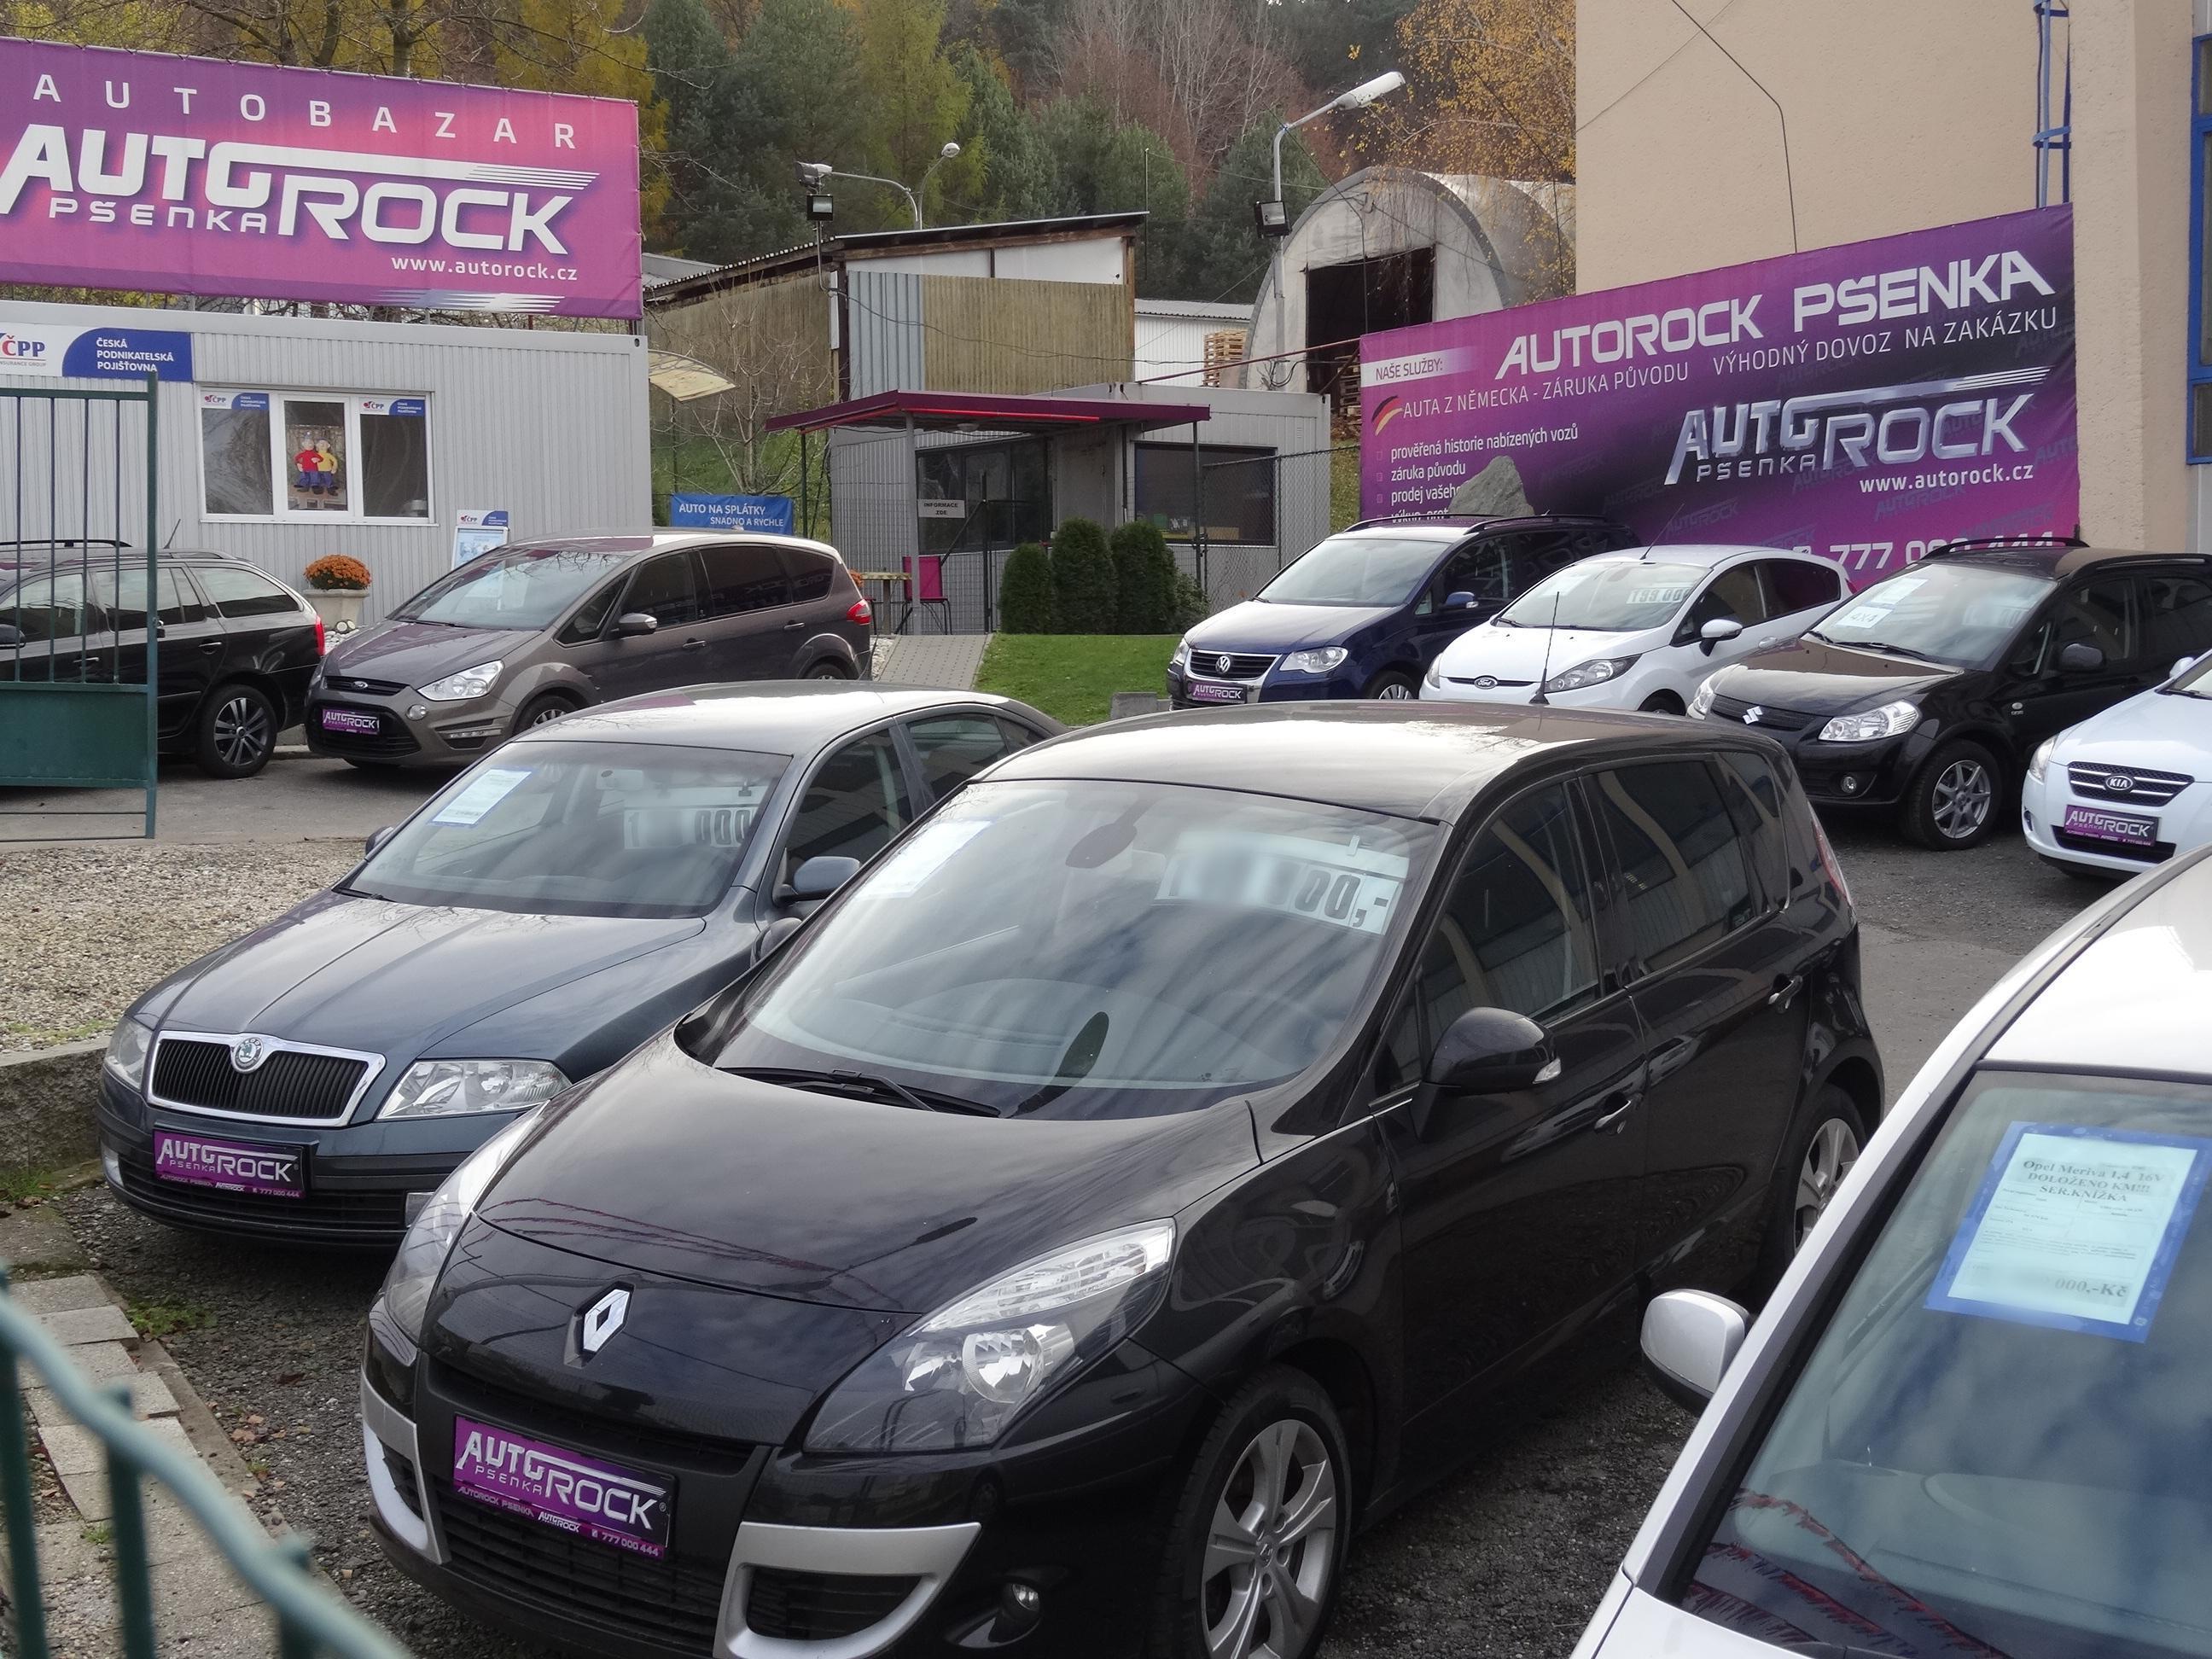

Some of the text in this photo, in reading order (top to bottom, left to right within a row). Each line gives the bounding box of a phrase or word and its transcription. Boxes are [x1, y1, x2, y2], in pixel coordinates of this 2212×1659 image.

[391, 256, 578, 281] www.autorock.cz
[2, 335, 45, 358] ČPP
[96, 337, 128, 348] ČESKÁ
[1494, 294, 1764, 380] AUTOROCK
[96, 351, 174, 362] PODNIKATELSKÁ
[96, 360, 158, 372] POJIŠŤOVNA
[1403, 398, 1441, 418] AUTA
[1444, 396, 1453, 413] Z
[1458, 385, 1528, 411] NĚMECKA
[1542, 373, 1609, 400] ZÁRUKA
[1614, 362, 1689, 390] PŮVODU
[1713, 340, 1809, 376] VÝHODNÝ
[1816, 331, 1892, 361] DOVOZ
[1905, 326, 1936, 349] NA
[1943, 306, 2057, 345] ZAKÁZKU
[1376, 358, 1443, 381] NAŠE SLUŽBY:
[1391, 423, 1579, 463] prověřená historie nabízených vozů
[1391, 460, 1466, 481] záruka původu
[1859, 463, 2034, 494] www.autorock.cz
[1391, 486, 1423, 506] prodej
[678, 503, 766, 515] AUTO NA SPLÁTKY
[710, 516, 783, 527] SNADNO A RYCHLE
[1830, 542, 1894, 570] 777
[2109, 777, 2128, 788] KIA
[2023, 1159, 2055, 1173] Opel
[2060, 1163, 2106, 1179] Meriva
[2111, 1170, 2130, 1180] 1.4
[2028, 1172, 2109, 1190] DOLOŽENO
[457, 1486, 499, 1506] AUTOROCK
[602, 1531, 620, 1545] 777
[621, 1539, 639, 1551] 000
[640, 1544, 659, 1557] 444
